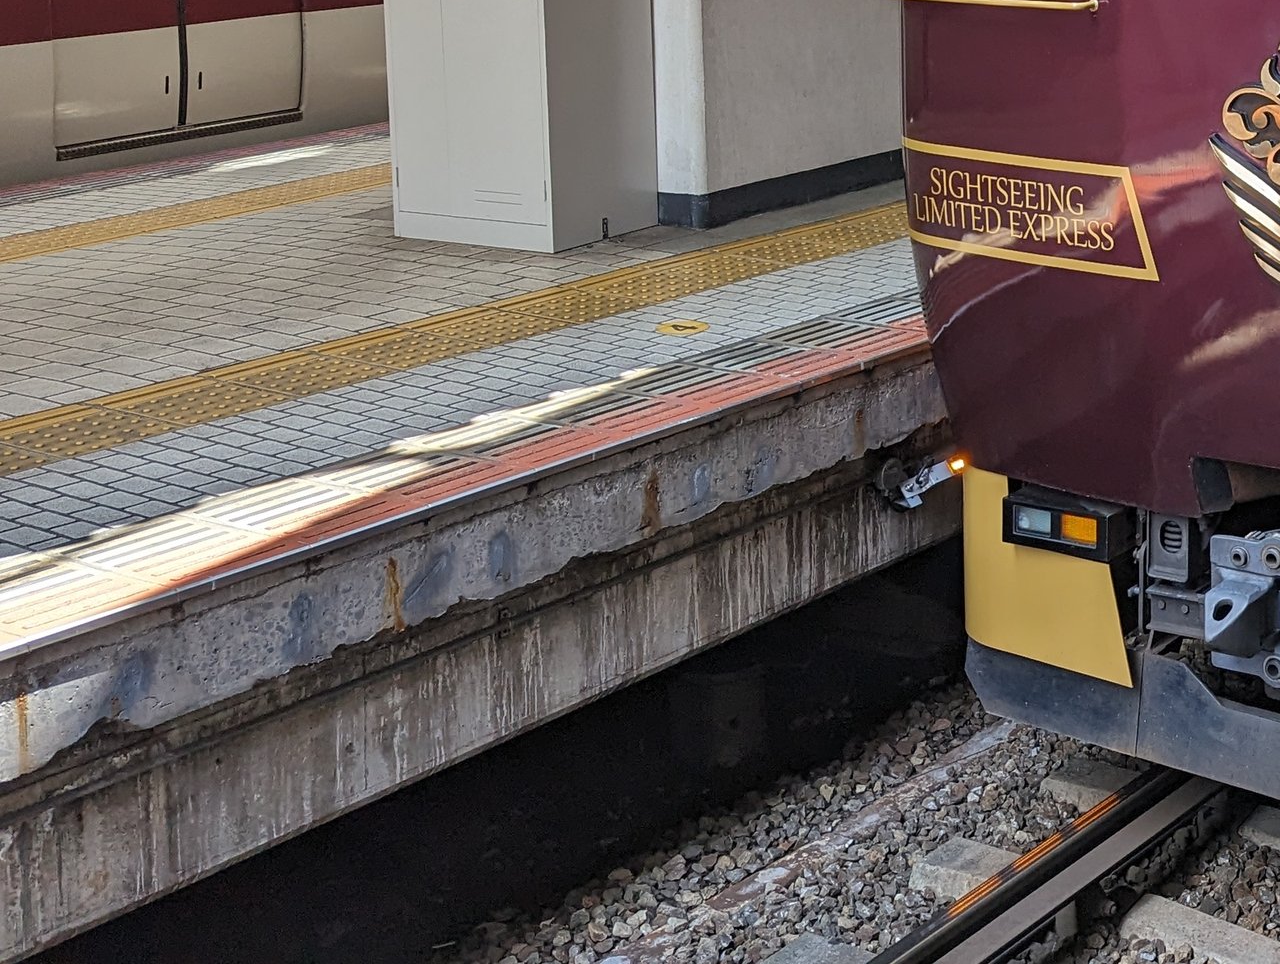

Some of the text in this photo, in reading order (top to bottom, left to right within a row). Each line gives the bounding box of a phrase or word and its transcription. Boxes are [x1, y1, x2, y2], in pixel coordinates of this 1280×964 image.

[930, 167, 1084, 215] SIGHTSEEING
[914, 193, 1115, 251] LIMITED EXPRESS
